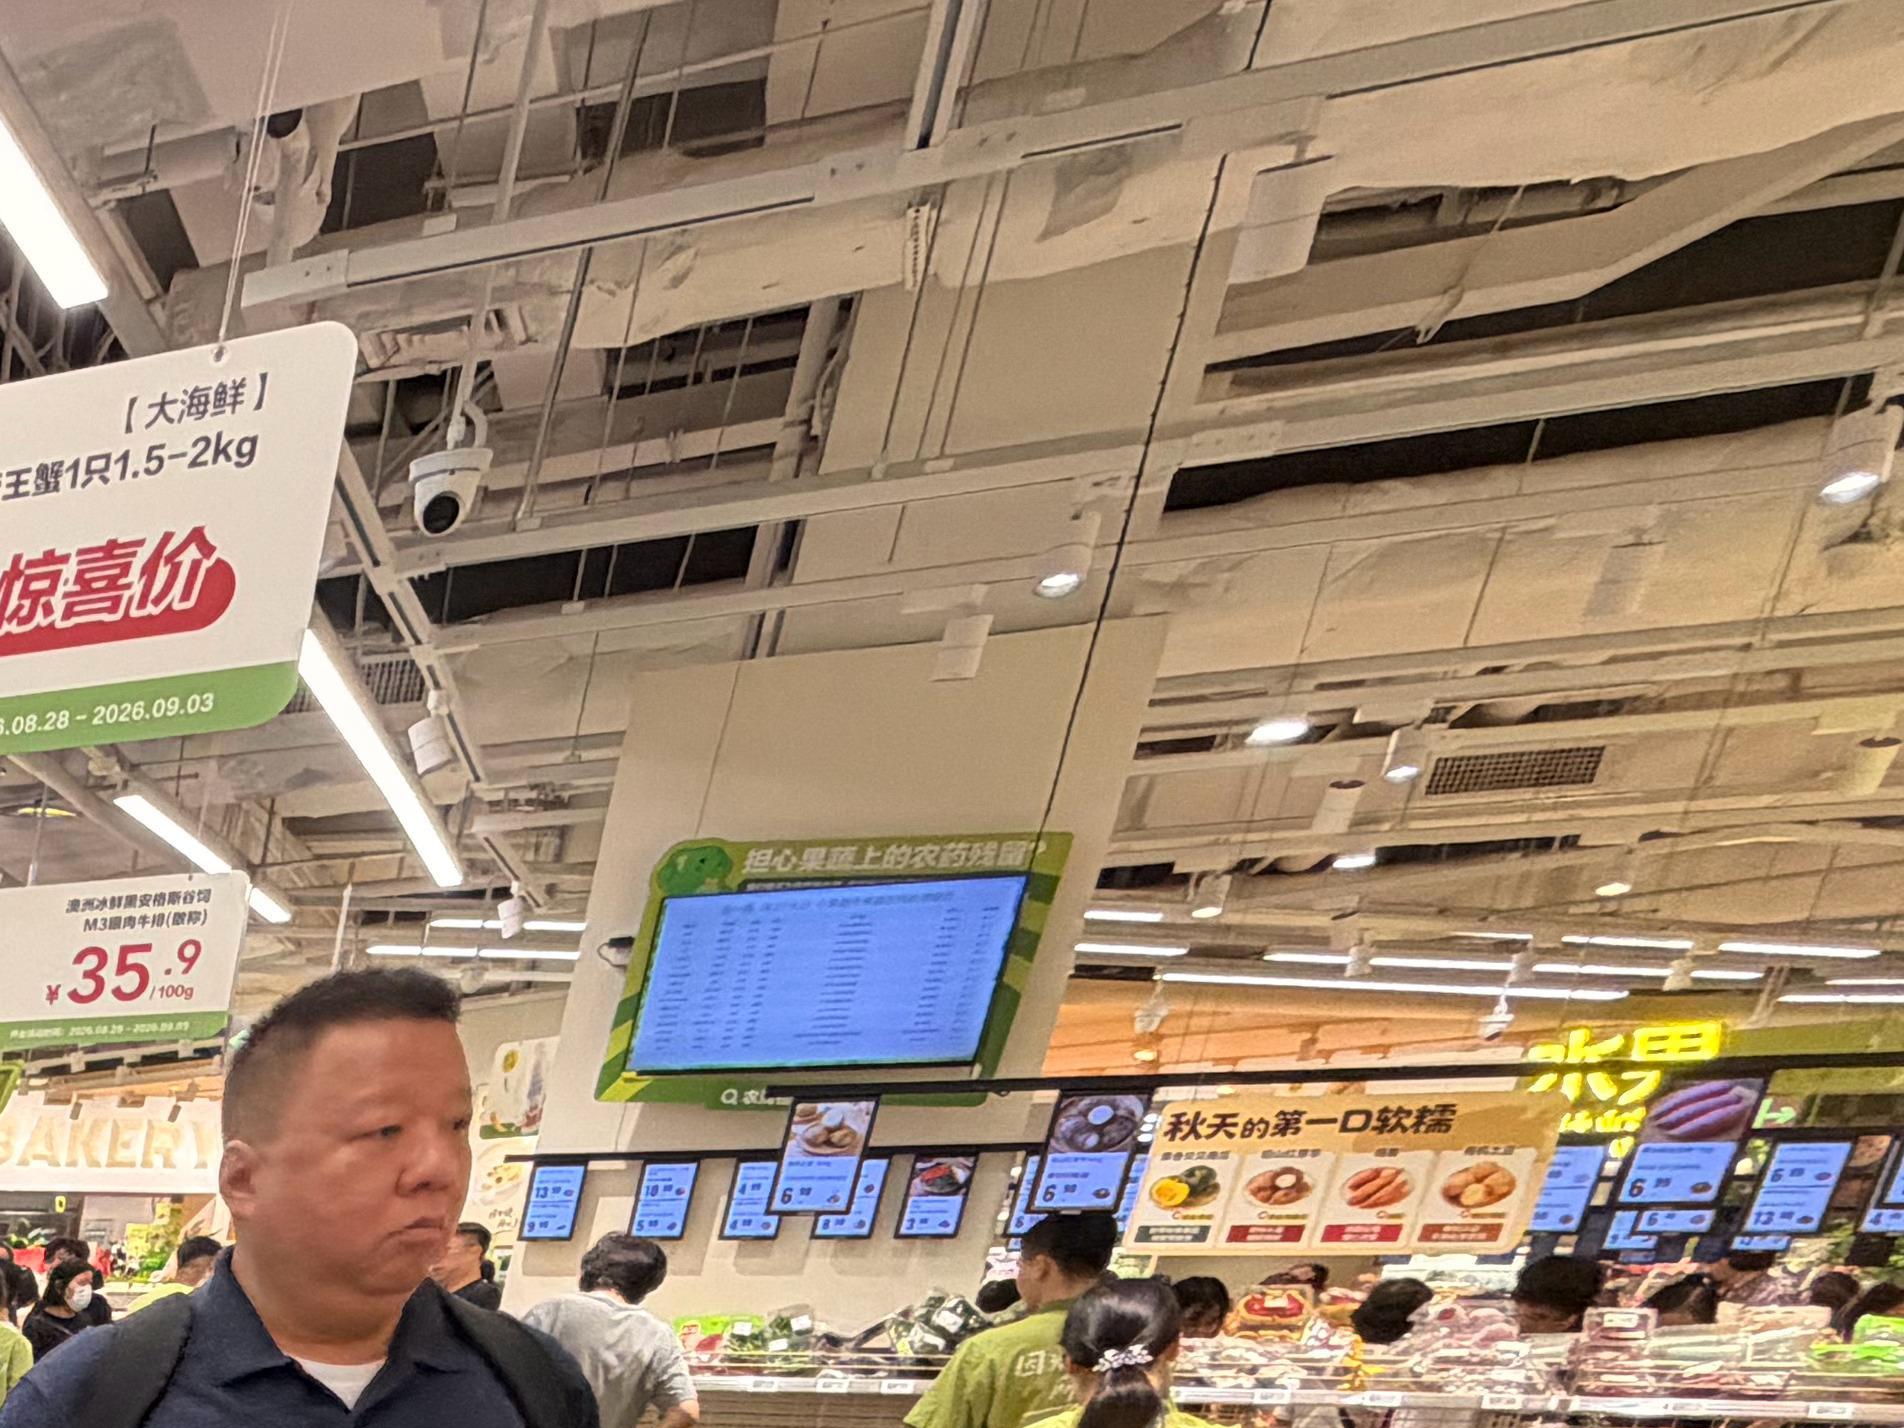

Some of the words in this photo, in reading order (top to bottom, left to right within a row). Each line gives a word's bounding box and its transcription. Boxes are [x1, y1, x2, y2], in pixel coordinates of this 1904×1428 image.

[123, 371, 270, 433] 【大海鲜】
[92, 692, 214, 726] 2026.09.03
[1163, 1104, 1457, 1142] 秋天的第一口软糯
[781, 1188, 793, 1204] 6
[1043, 1185, 1056, 1202] 6
[1630, 1178, 1644, 1197] 6
